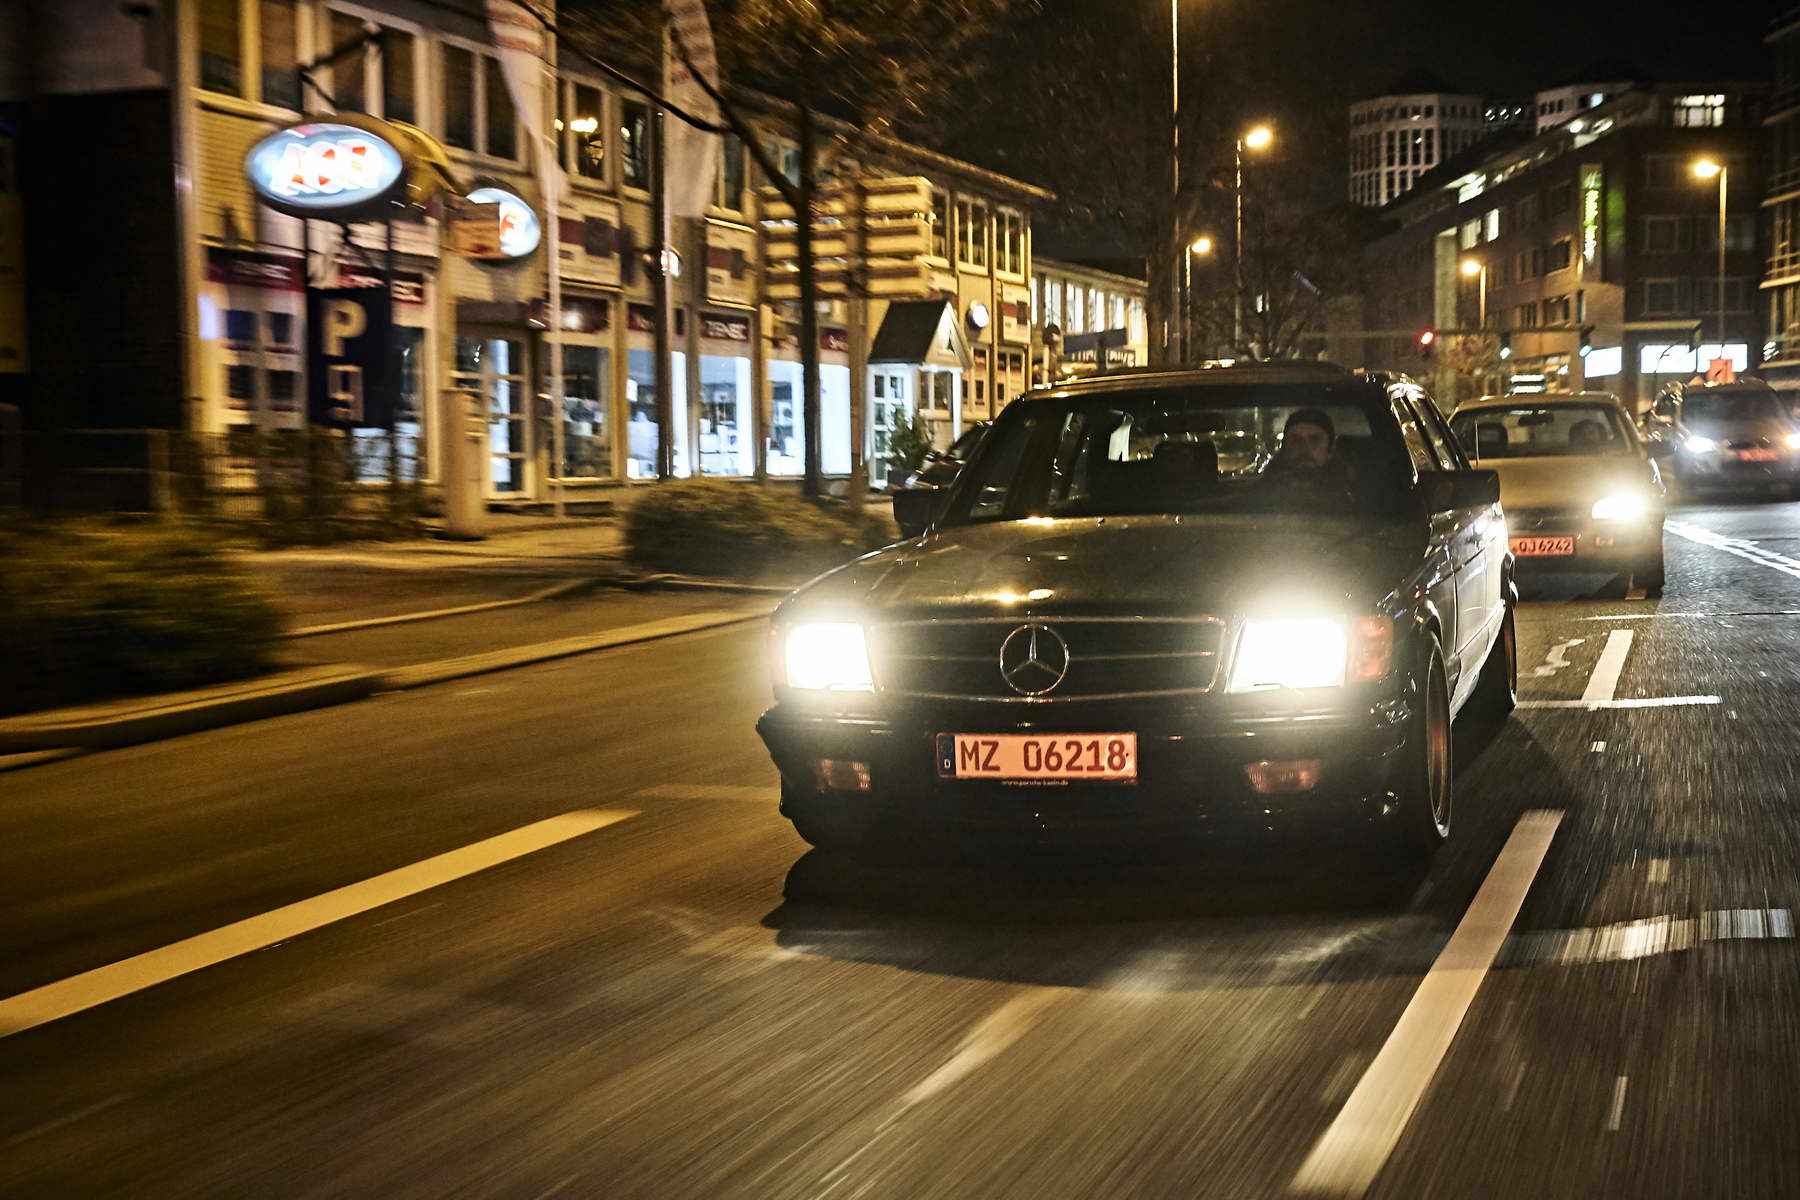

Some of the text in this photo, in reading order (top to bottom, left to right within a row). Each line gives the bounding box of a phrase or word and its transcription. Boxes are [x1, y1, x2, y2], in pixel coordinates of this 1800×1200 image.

[321, 298, 367, 357] P
[943, 758, 951, 769] D
[960, 739, 1127, 772] MZ 06218
